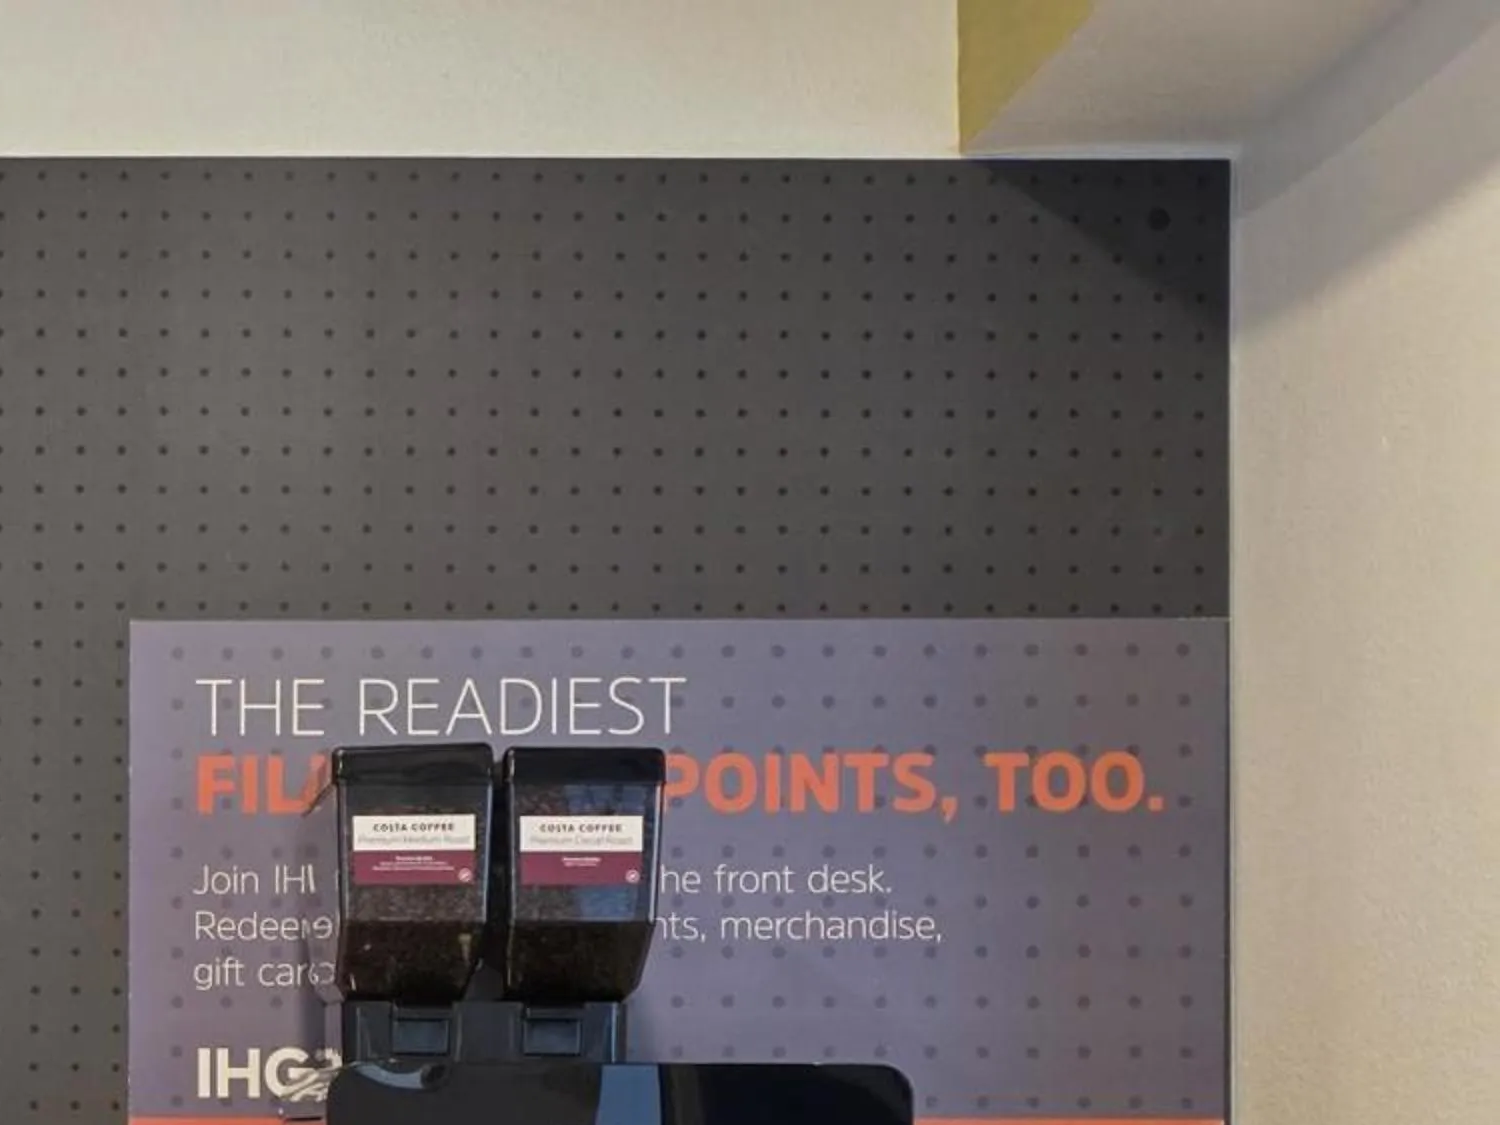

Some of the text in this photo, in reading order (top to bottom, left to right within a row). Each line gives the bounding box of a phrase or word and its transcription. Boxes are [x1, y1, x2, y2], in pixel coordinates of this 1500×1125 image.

[195, 677, 687, 737] THE READIEST
[664, 752, 958, 823] POINTS,
[983, 751, 1164, 812] TOO.
[193, 864, 259, 895] Join
[658, 863, 892, 894] he front desk.
[721, 910, 945, 943] merchandise,
[193, 956, 245, 991] gift
